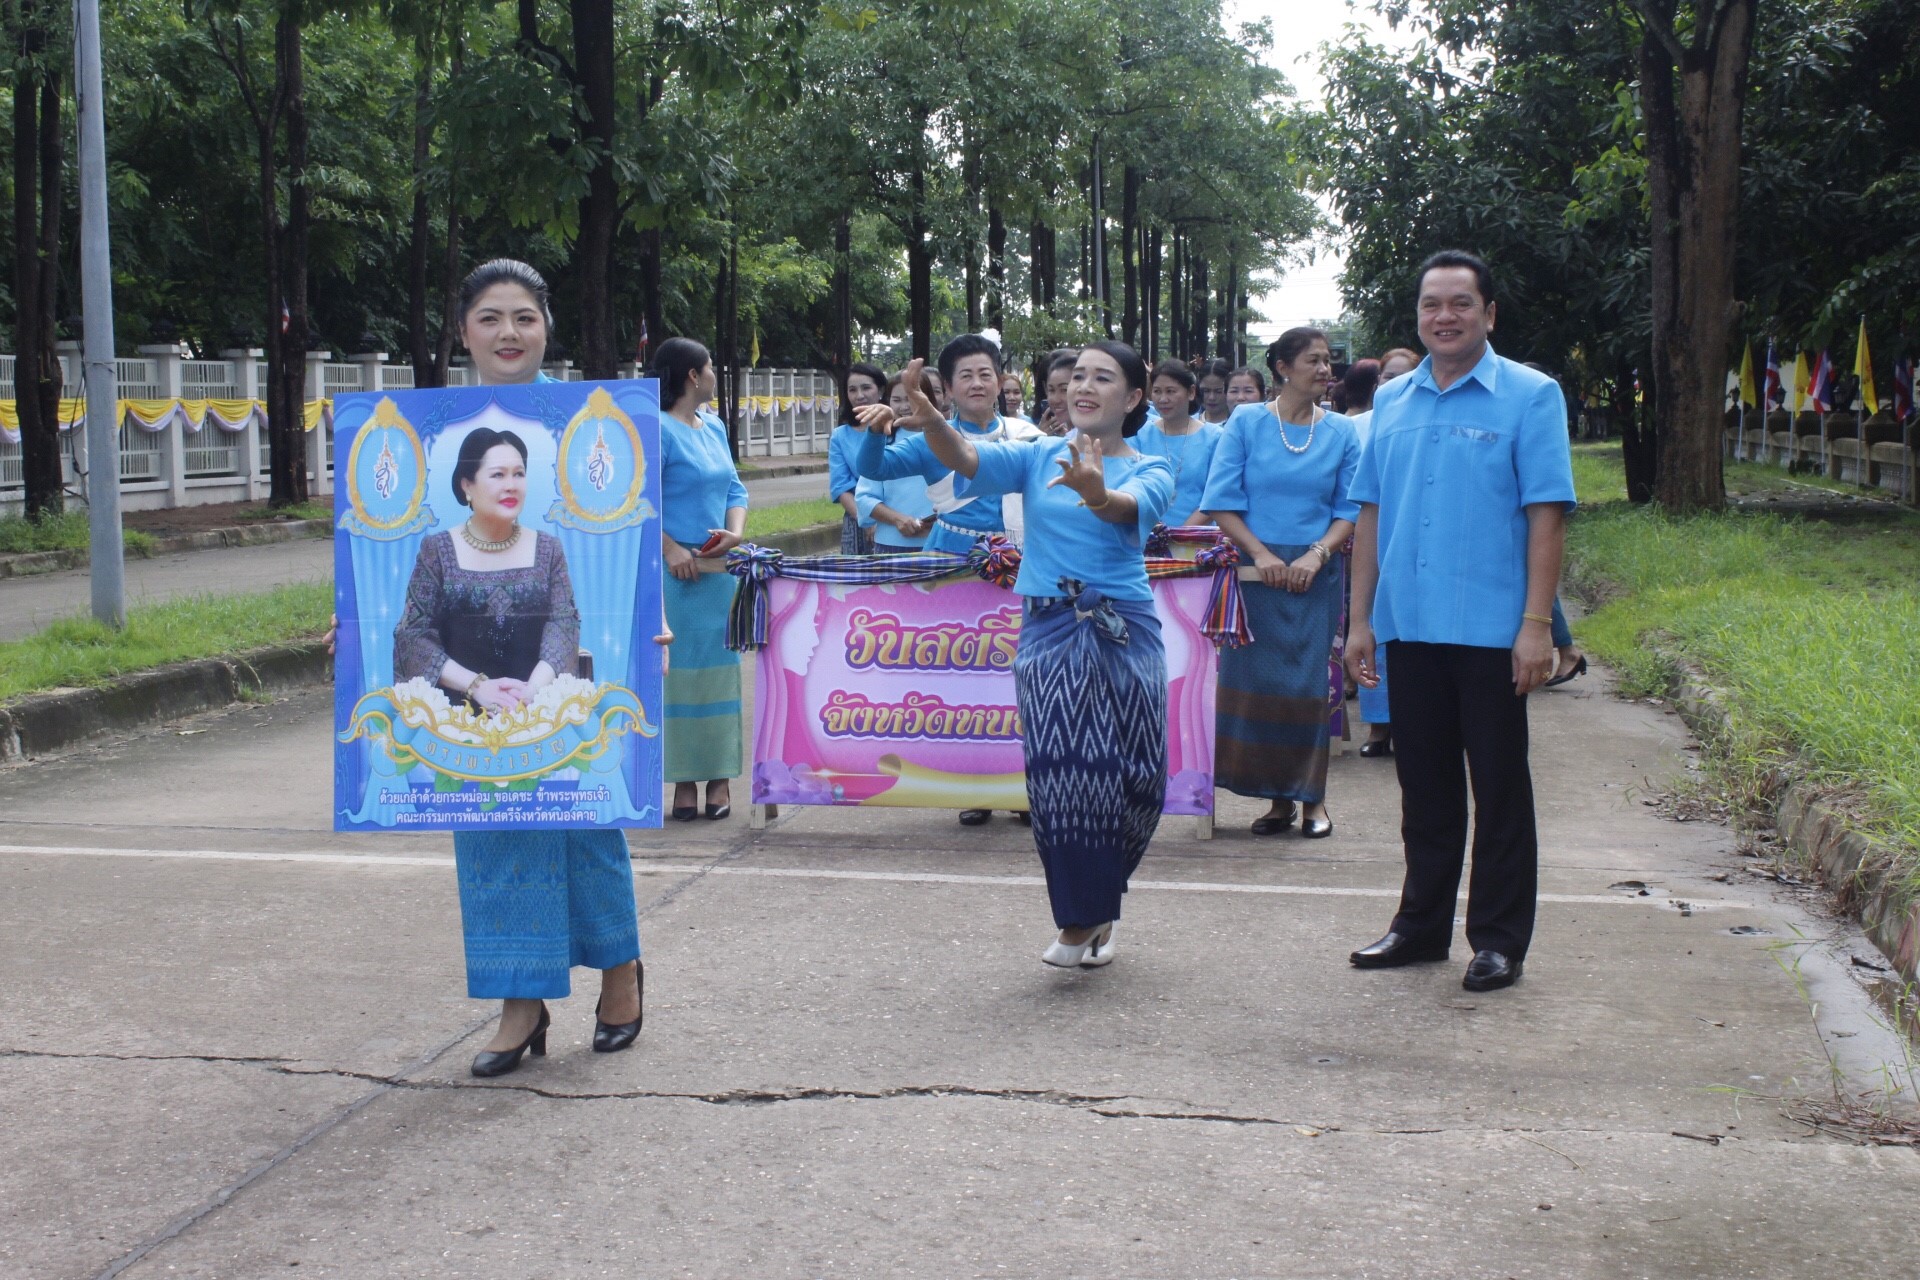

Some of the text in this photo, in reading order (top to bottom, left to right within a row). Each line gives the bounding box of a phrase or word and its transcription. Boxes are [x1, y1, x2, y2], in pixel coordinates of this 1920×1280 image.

[379, 785, 610, 806] ด้วยเกล้าด้วยกระหม่อม ขอเดชะ ข้าพระพุทธเจ้า
[396, 805, 597, 823] คณะกรรมการพัฒนาสตรีจังหวัดหนองคาย
